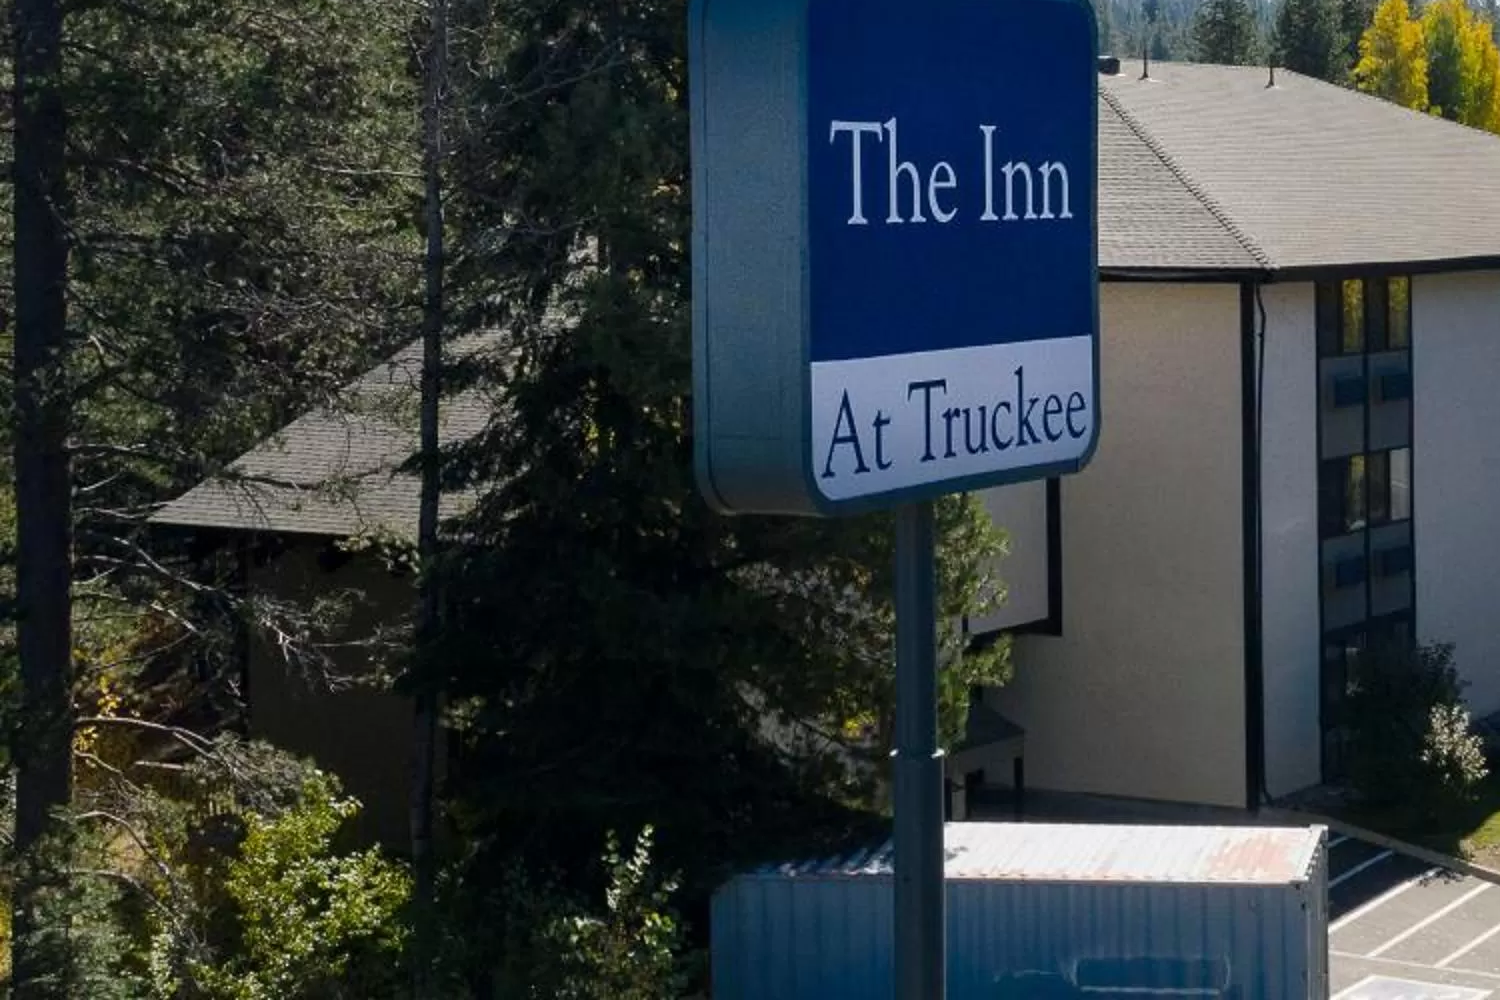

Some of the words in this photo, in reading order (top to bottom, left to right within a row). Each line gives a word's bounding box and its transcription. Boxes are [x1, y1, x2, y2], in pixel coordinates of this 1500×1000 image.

[829, 117, 959, 225] The
[979, 124, 1073, 222] Inn
[821, 388, 893, 479] At
[907, 366, 1087, 462] Truckee
